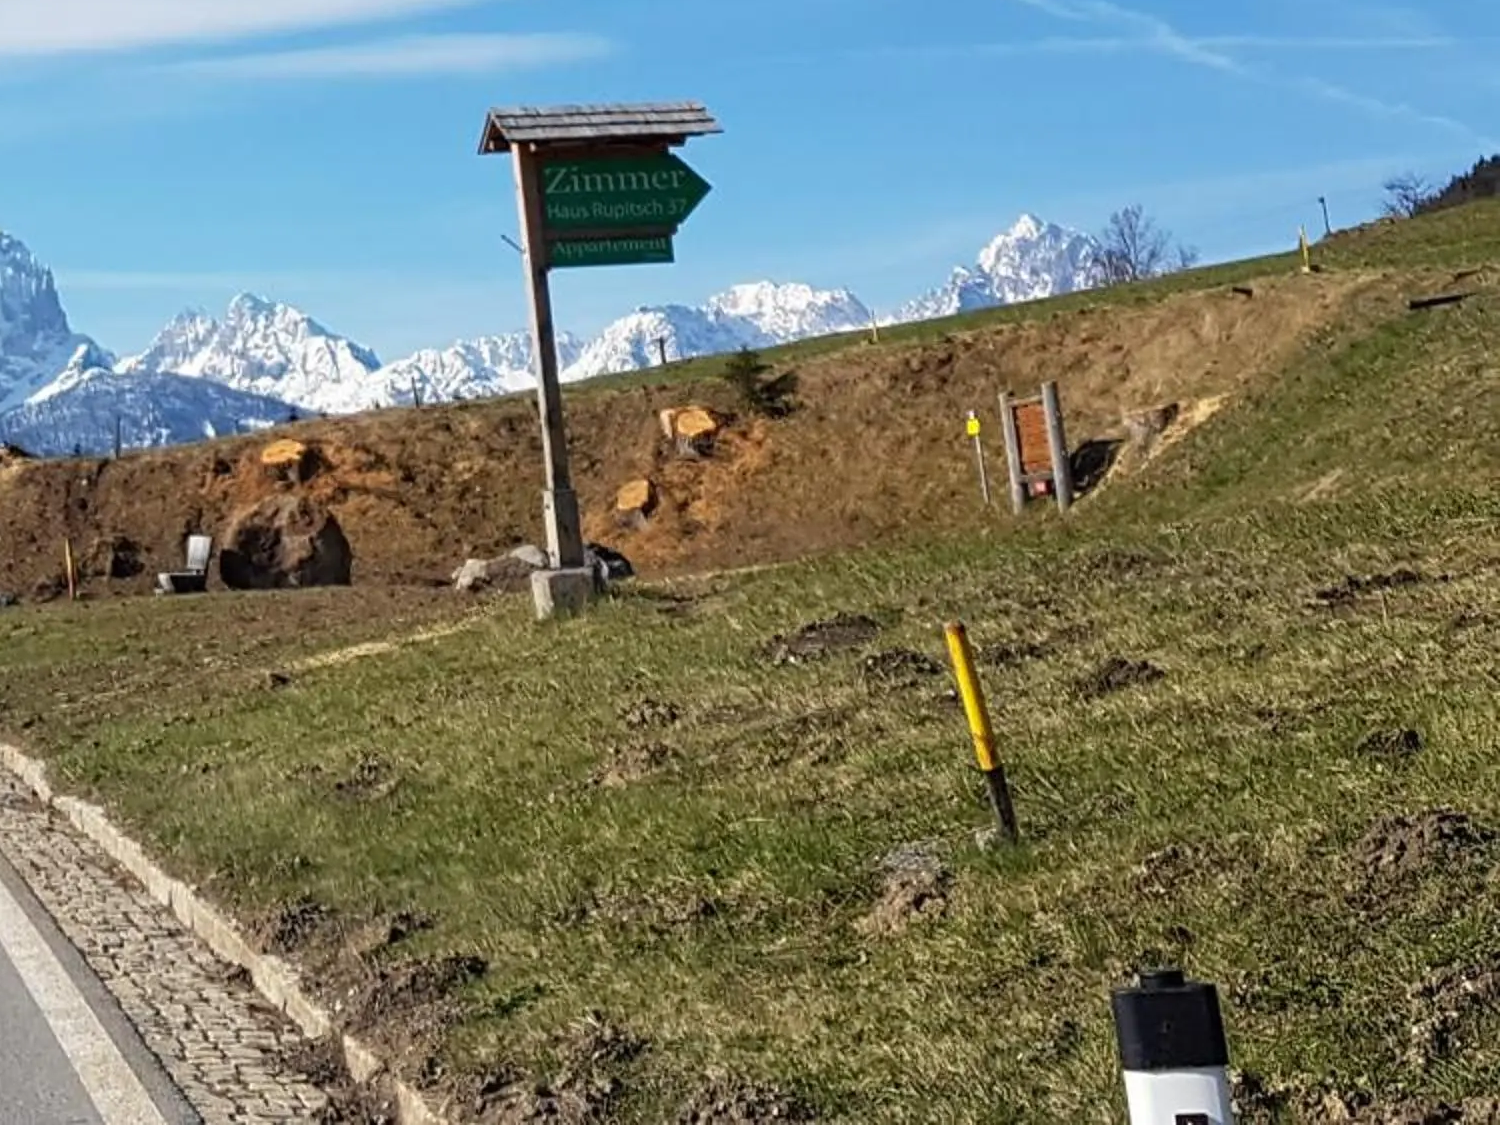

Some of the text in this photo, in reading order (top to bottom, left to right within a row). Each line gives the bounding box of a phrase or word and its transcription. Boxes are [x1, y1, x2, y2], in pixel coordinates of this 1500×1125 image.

[545, 166, 685, 194] Zimmer
[546, 204, 590, 220] Haus
[668, 199, 687, 215] 37
[553, 236, 667, 258] Appartement
